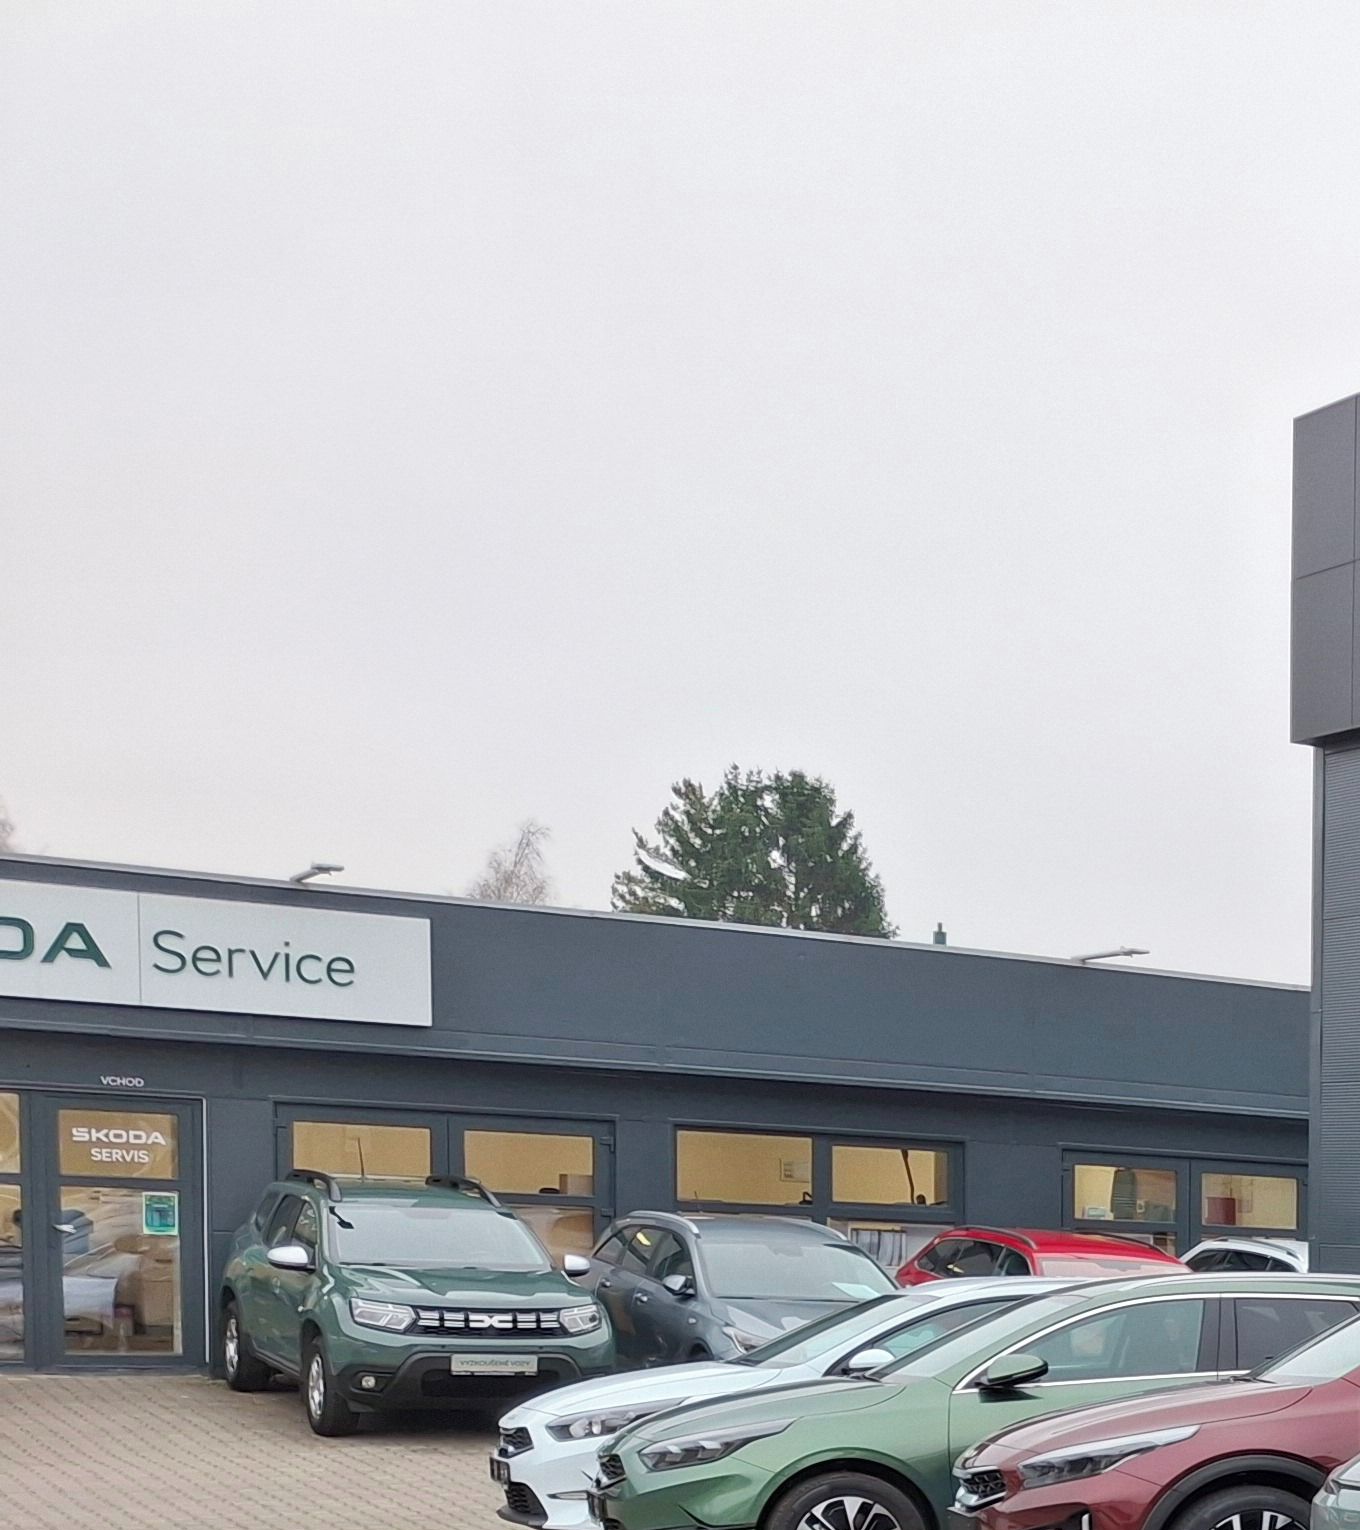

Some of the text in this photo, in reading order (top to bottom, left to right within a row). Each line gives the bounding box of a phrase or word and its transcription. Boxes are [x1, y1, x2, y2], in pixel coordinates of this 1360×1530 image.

[152, 929, 356, 987] Service
[100, 1075, 145, 1088] VCHOD
[90, 1148, 150, 1164] SERVIS
